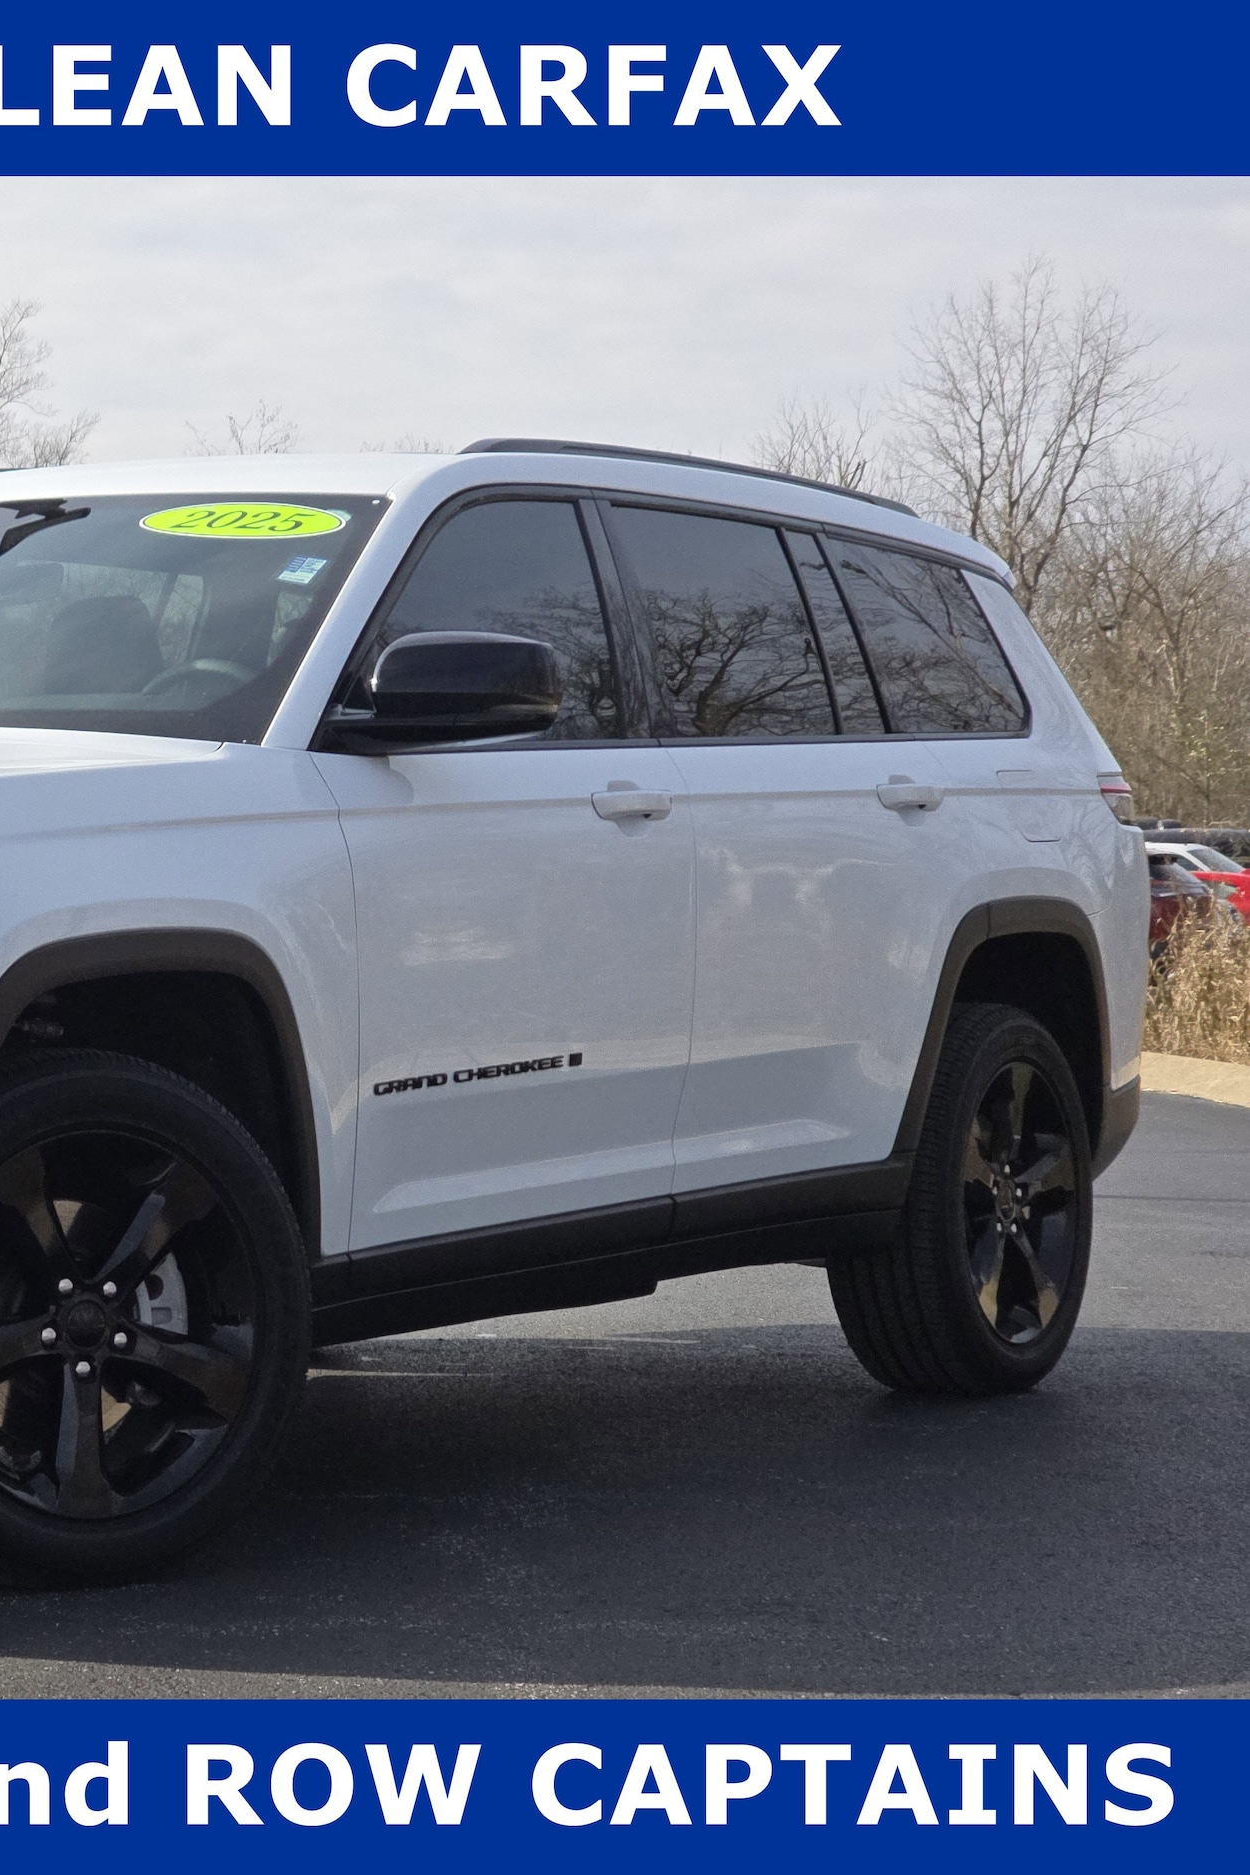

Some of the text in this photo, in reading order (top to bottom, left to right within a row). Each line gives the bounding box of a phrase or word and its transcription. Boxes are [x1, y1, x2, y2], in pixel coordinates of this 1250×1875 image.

[169, 509, 316, 532] 2025
[373, 1072, 448, 1096] GRAND
[453, 1054, 565, 1084] CHEROKEE
